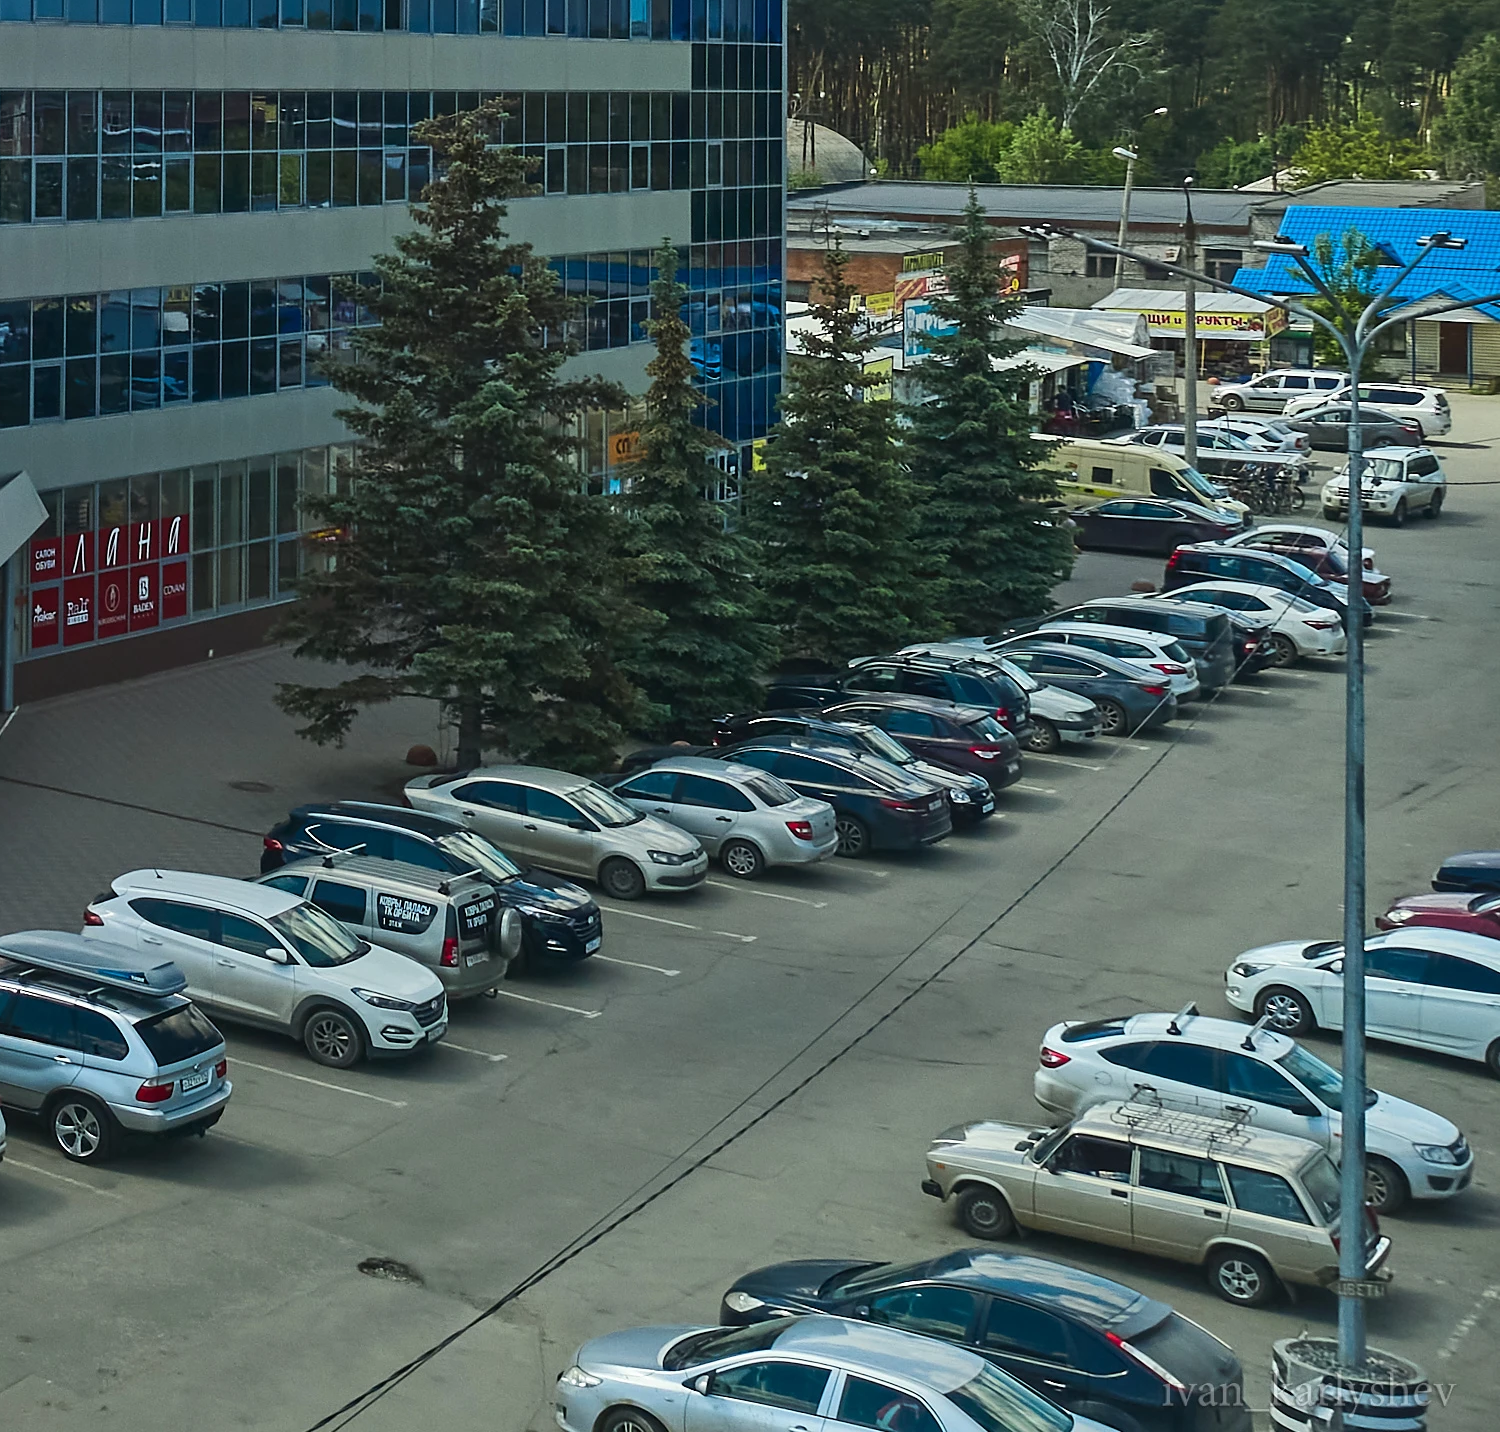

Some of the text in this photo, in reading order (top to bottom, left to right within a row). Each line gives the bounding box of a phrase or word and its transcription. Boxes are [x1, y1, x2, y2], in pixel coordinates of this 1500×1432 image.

[1193, 316, 1244, 327] РУКТЫ
[35, 548, 56, 560] САЛОН
[35, 559, 56, 572] ОБУВИ
[133, 601, 154, 614] BADEN
[384, 906, 420, 923] ТК ОРБИТА
